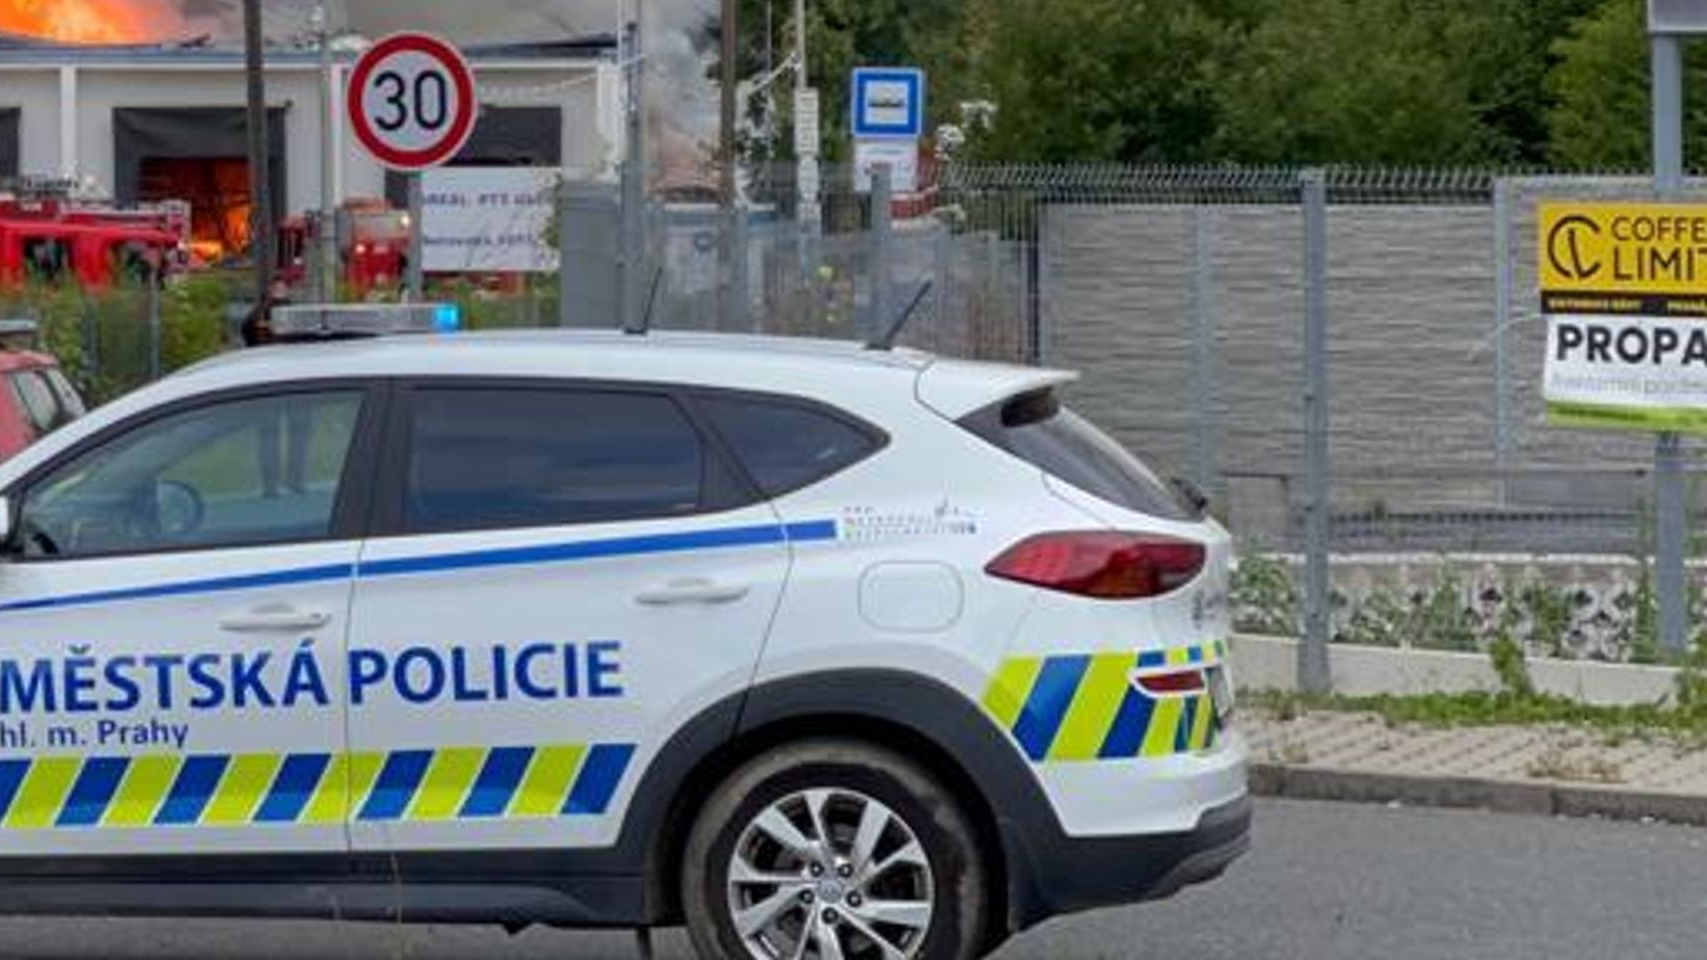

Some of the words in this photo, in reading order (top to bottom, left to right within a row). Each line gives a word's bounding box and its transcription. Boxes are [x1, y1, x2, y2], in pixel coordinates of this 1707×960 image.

[373, 70, 447, 131] 30
[1556, 324, 1707, 365] PROPA
[0, 638, 329, 714] MĚSTSKÁ
[347, 641, 625, 705] POLICIE
[0, 722, 35, 748] hl.
[48, 724, 85, 746] m.
[98, 719, 189, 748] Prahy
